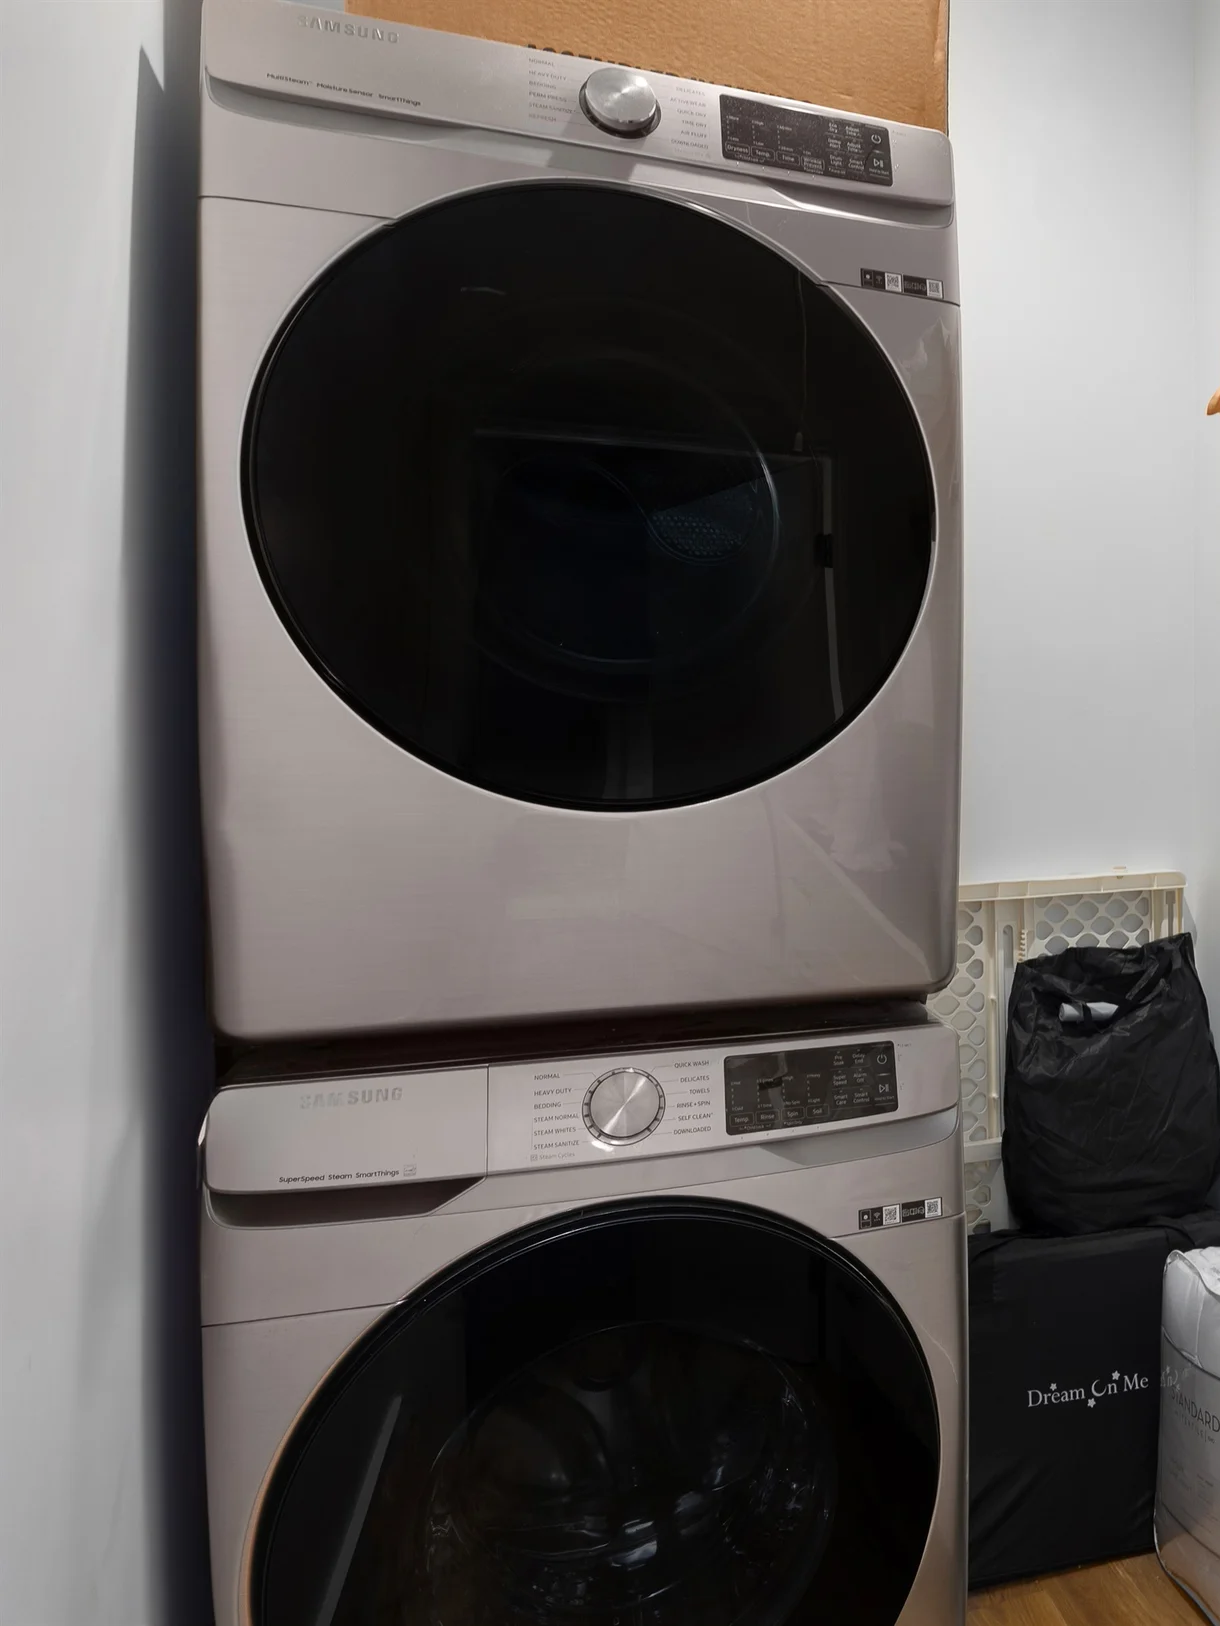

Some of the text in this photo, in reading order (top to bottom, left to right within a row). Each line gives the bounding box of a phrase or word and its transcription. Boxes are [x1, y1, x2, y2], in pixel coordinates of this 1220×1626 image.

[298, 15, 400, 44] SAMSUNG
[316, 82, 348, 93] Moisture
[349, 88, 373, 98] Sensor
[378, 93, 421, 106] SmartThings
[727, 144, 749, 154] Dryness
[534, 1073, 561, 1081] NORMAL
[680, 1075, 710, 1083] DELICATES
[689, 1087, 711, 1095] TOWELS
[300, 1087, 403, 1110] SAMSUNG
[534, 1102, 561, 1110] BEDDING
[534, 1113, 579, 1123] STEAM NORMAL
[678, 1114, 691, 1122] SELF
[673, 1125, 712, 1135] DOWNLOADED
[534, 1142, 554, 1150] STEAM
[557, 1151, 575, 1160] Cycles
[279, 1174, 325, 1184] SuperSpeed
[328, 1173, 352, 1181] Steam
[355, 1168, 400, 1179] SmartThings
[1027, 1387, 1086, 1407] Dream
[1091, 1379, 1118, 1397] On
[1123, 1373, 1149, 1392] Me
[1170, 1388, 1220, 1433] STANDARD
